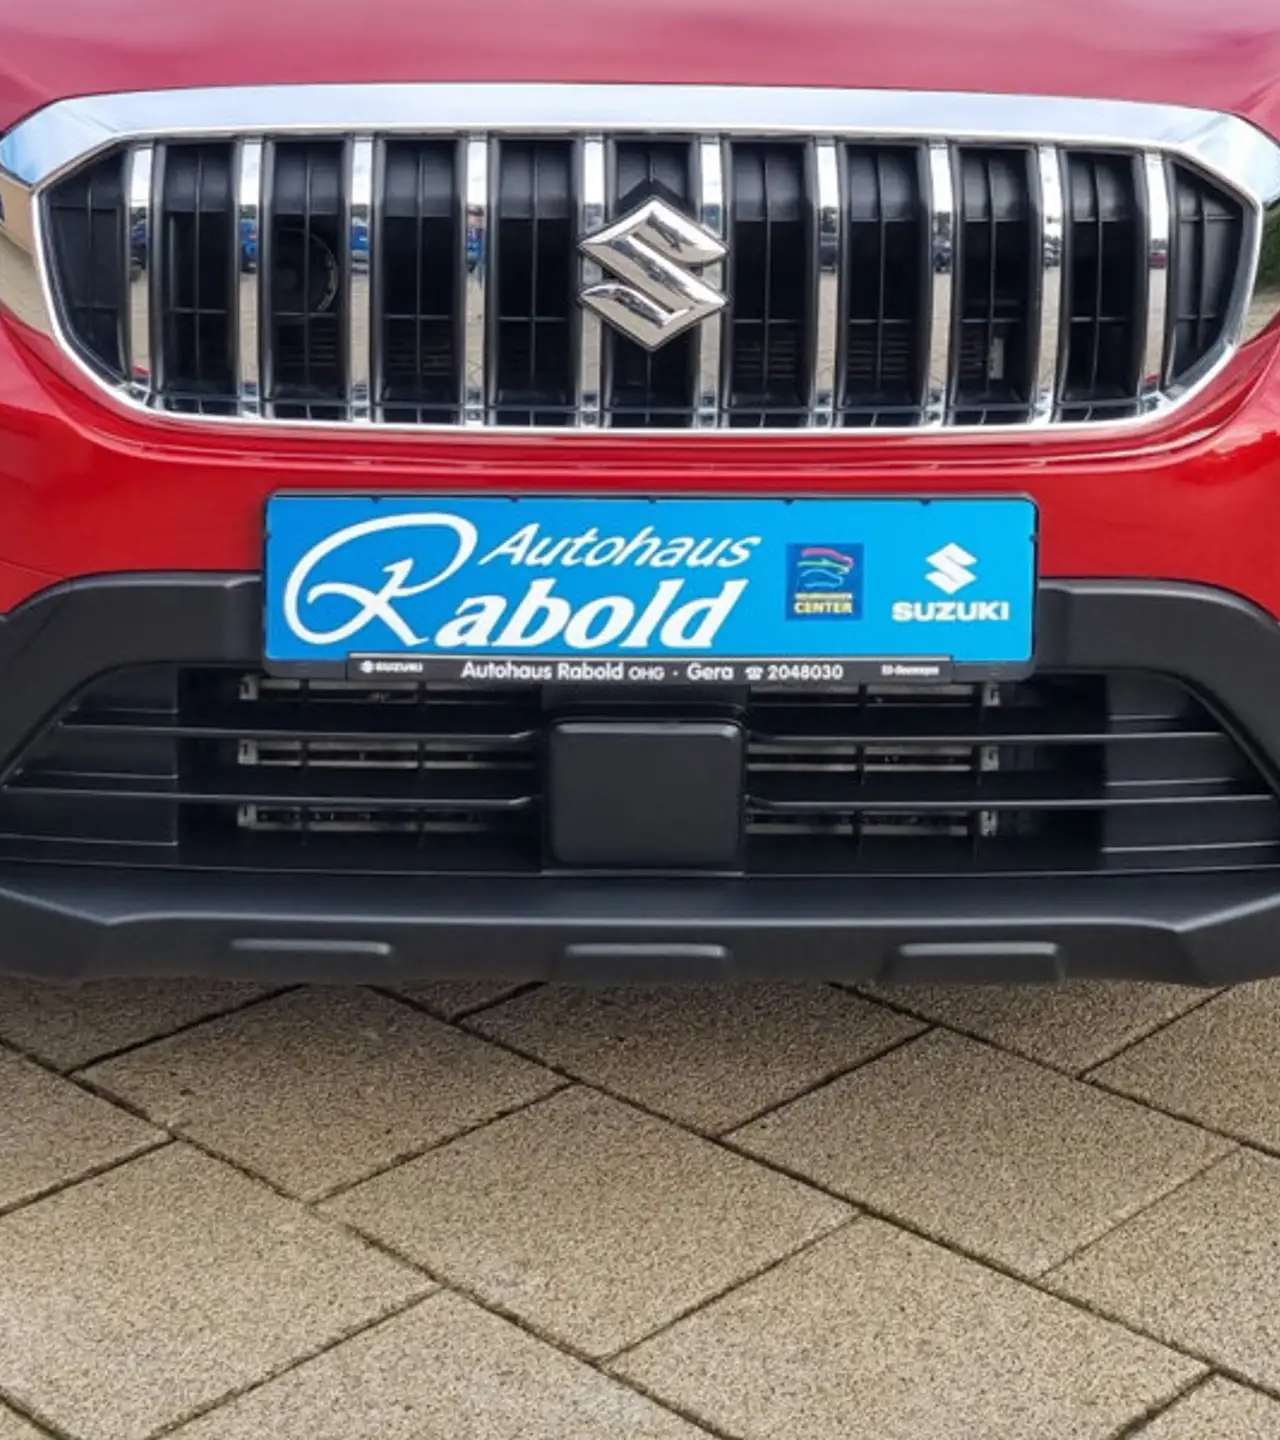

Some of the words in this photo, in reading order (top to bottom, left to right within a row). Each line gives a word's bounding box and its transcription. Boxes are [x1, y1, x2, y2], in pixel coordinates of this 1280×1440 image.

[478, 523, 762, 569] Autohaus
[283, 512, 749, 649] Rabold
[793, 601, 853, 615] CENTER
[891, 600, 1010, 622] SUZUKI
[459, 661, 553, 680] Autohaus
[557, 661, 625, 680] Rabold
[686, 662, 735, 681] Gera
[767, 663, 844, 680] 2048030
